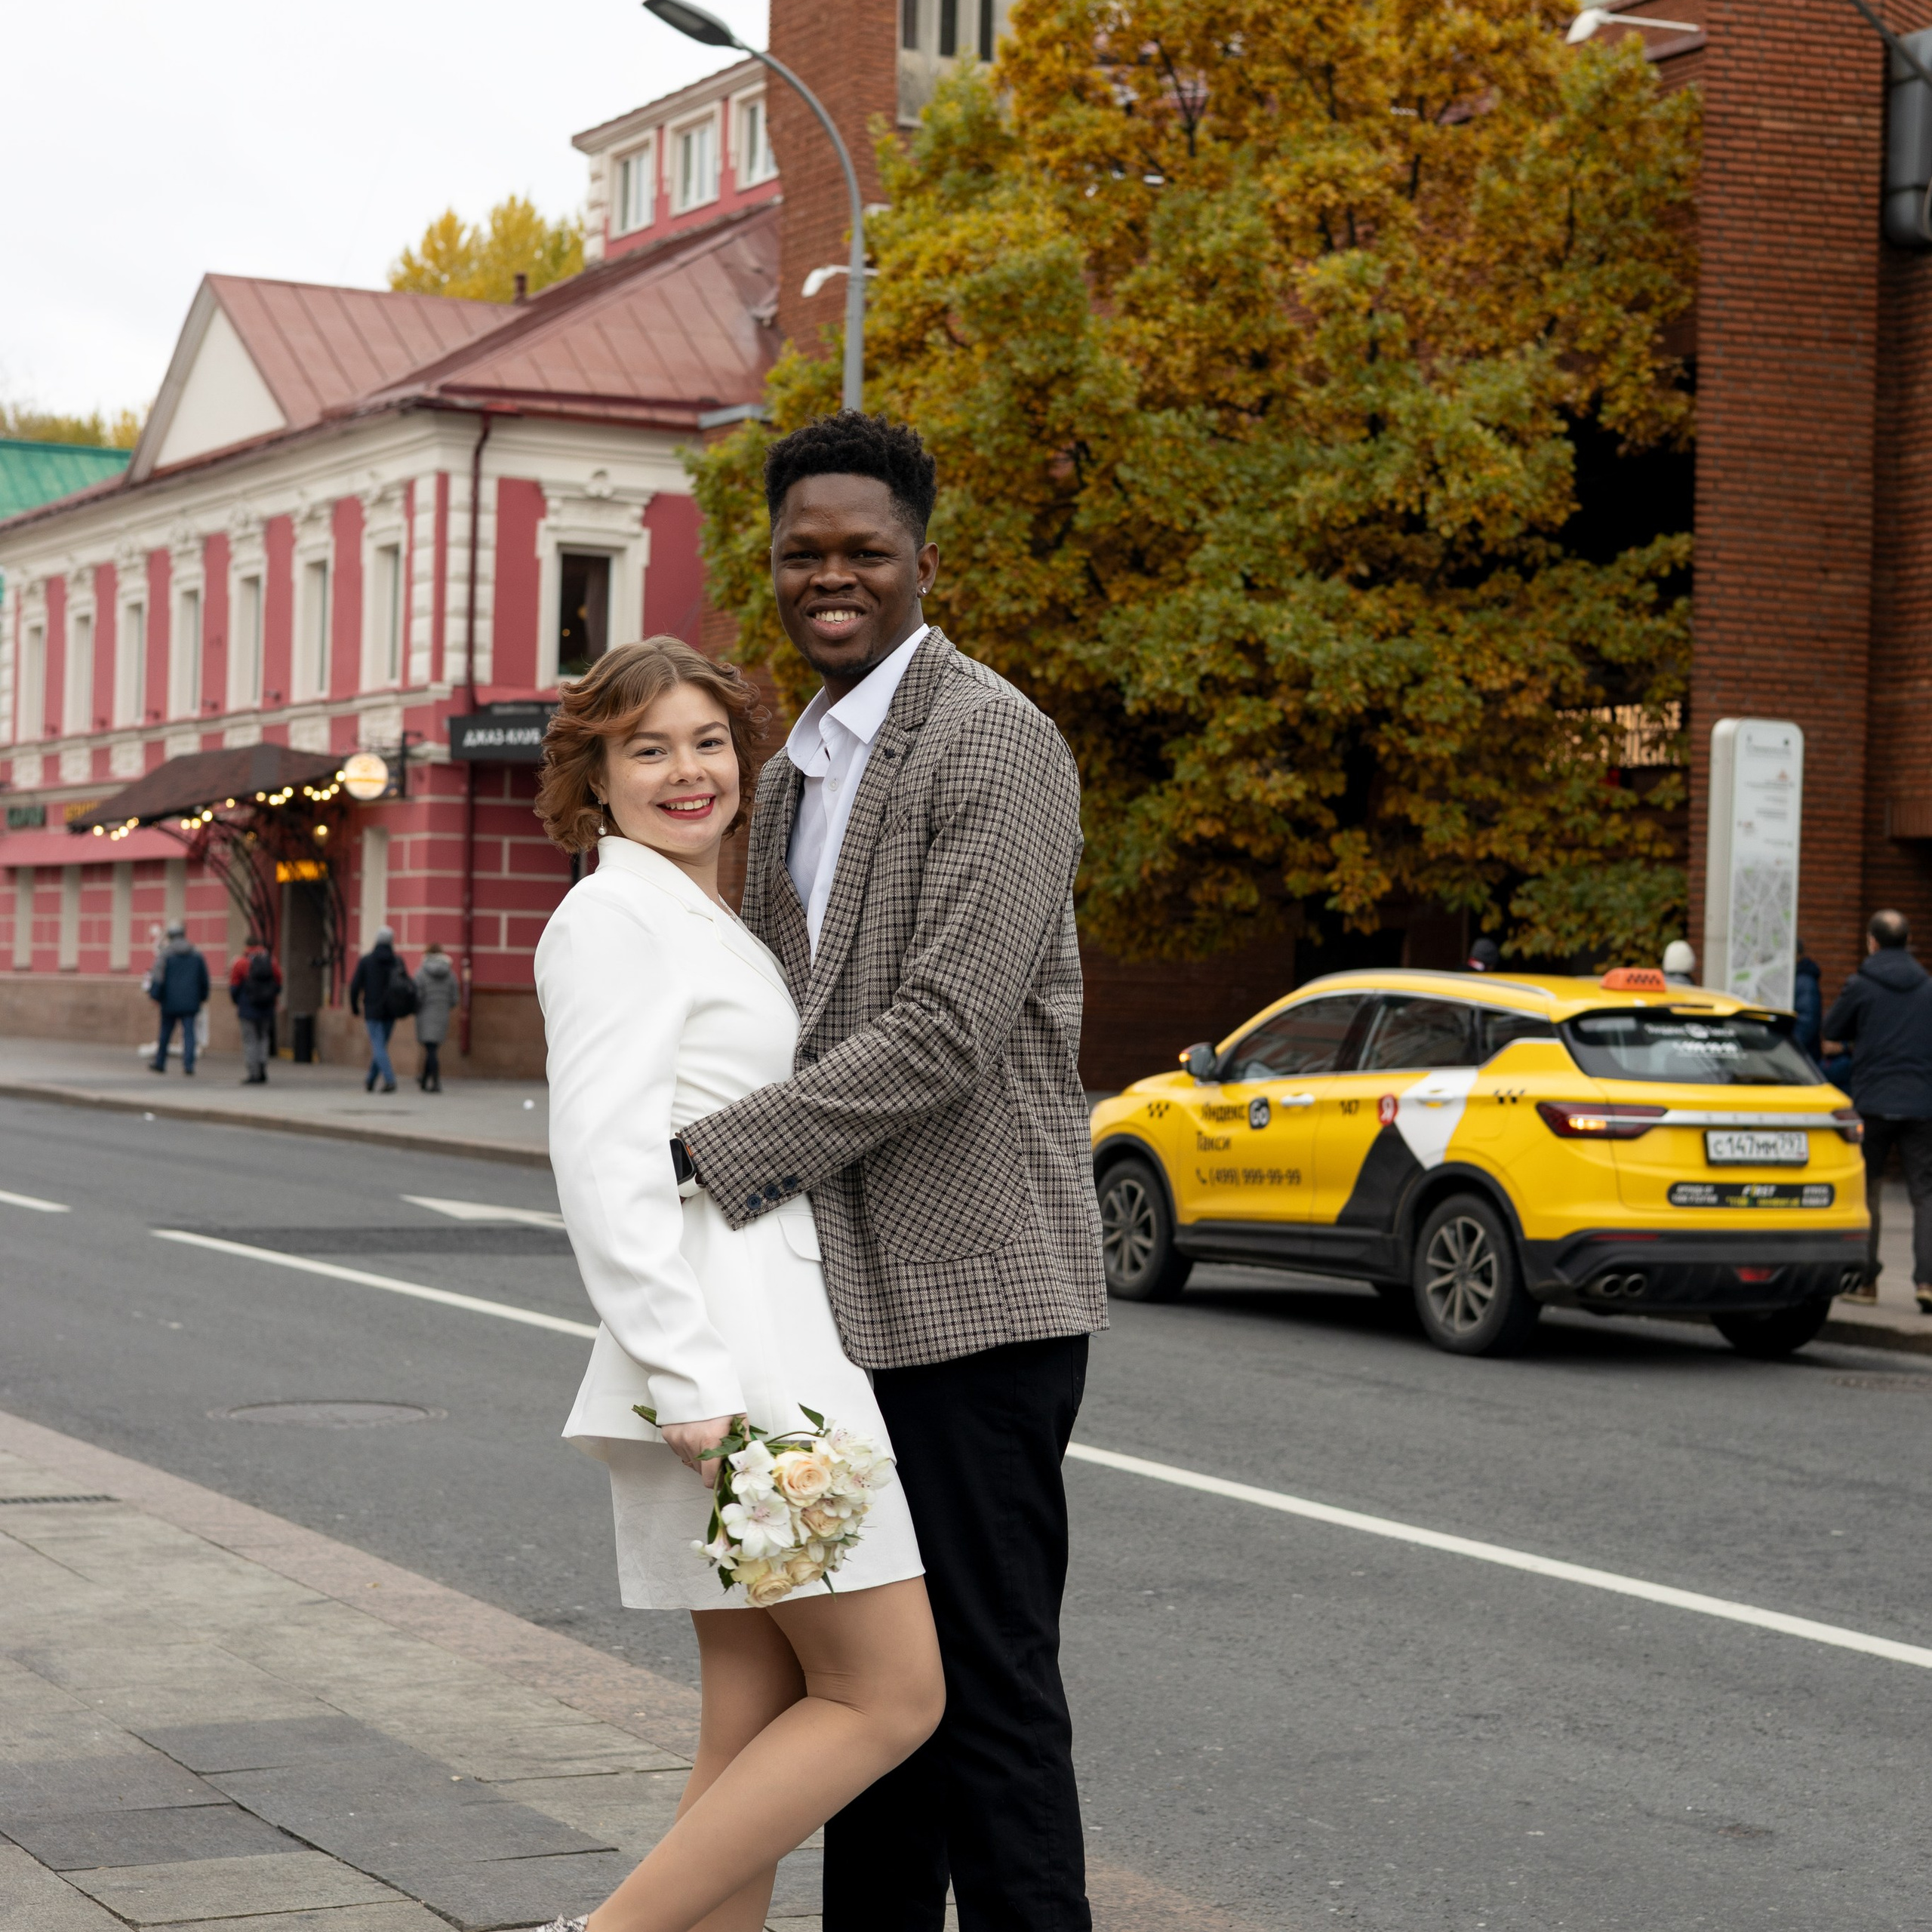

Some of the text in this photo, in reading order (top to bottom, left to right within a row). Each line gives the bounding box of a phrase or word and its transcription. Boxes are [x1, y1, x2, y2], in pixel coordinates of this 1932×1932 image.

[1201, 1103, 1245, 1122] Яндекс
[1340, 1099, 1359, 1115] 147
[1380, 1095, 1395, 1123] Я
[1196, 1131, 1232, 1151] Такси
[1242, 1168, 1302, 1186] 999-99-99
